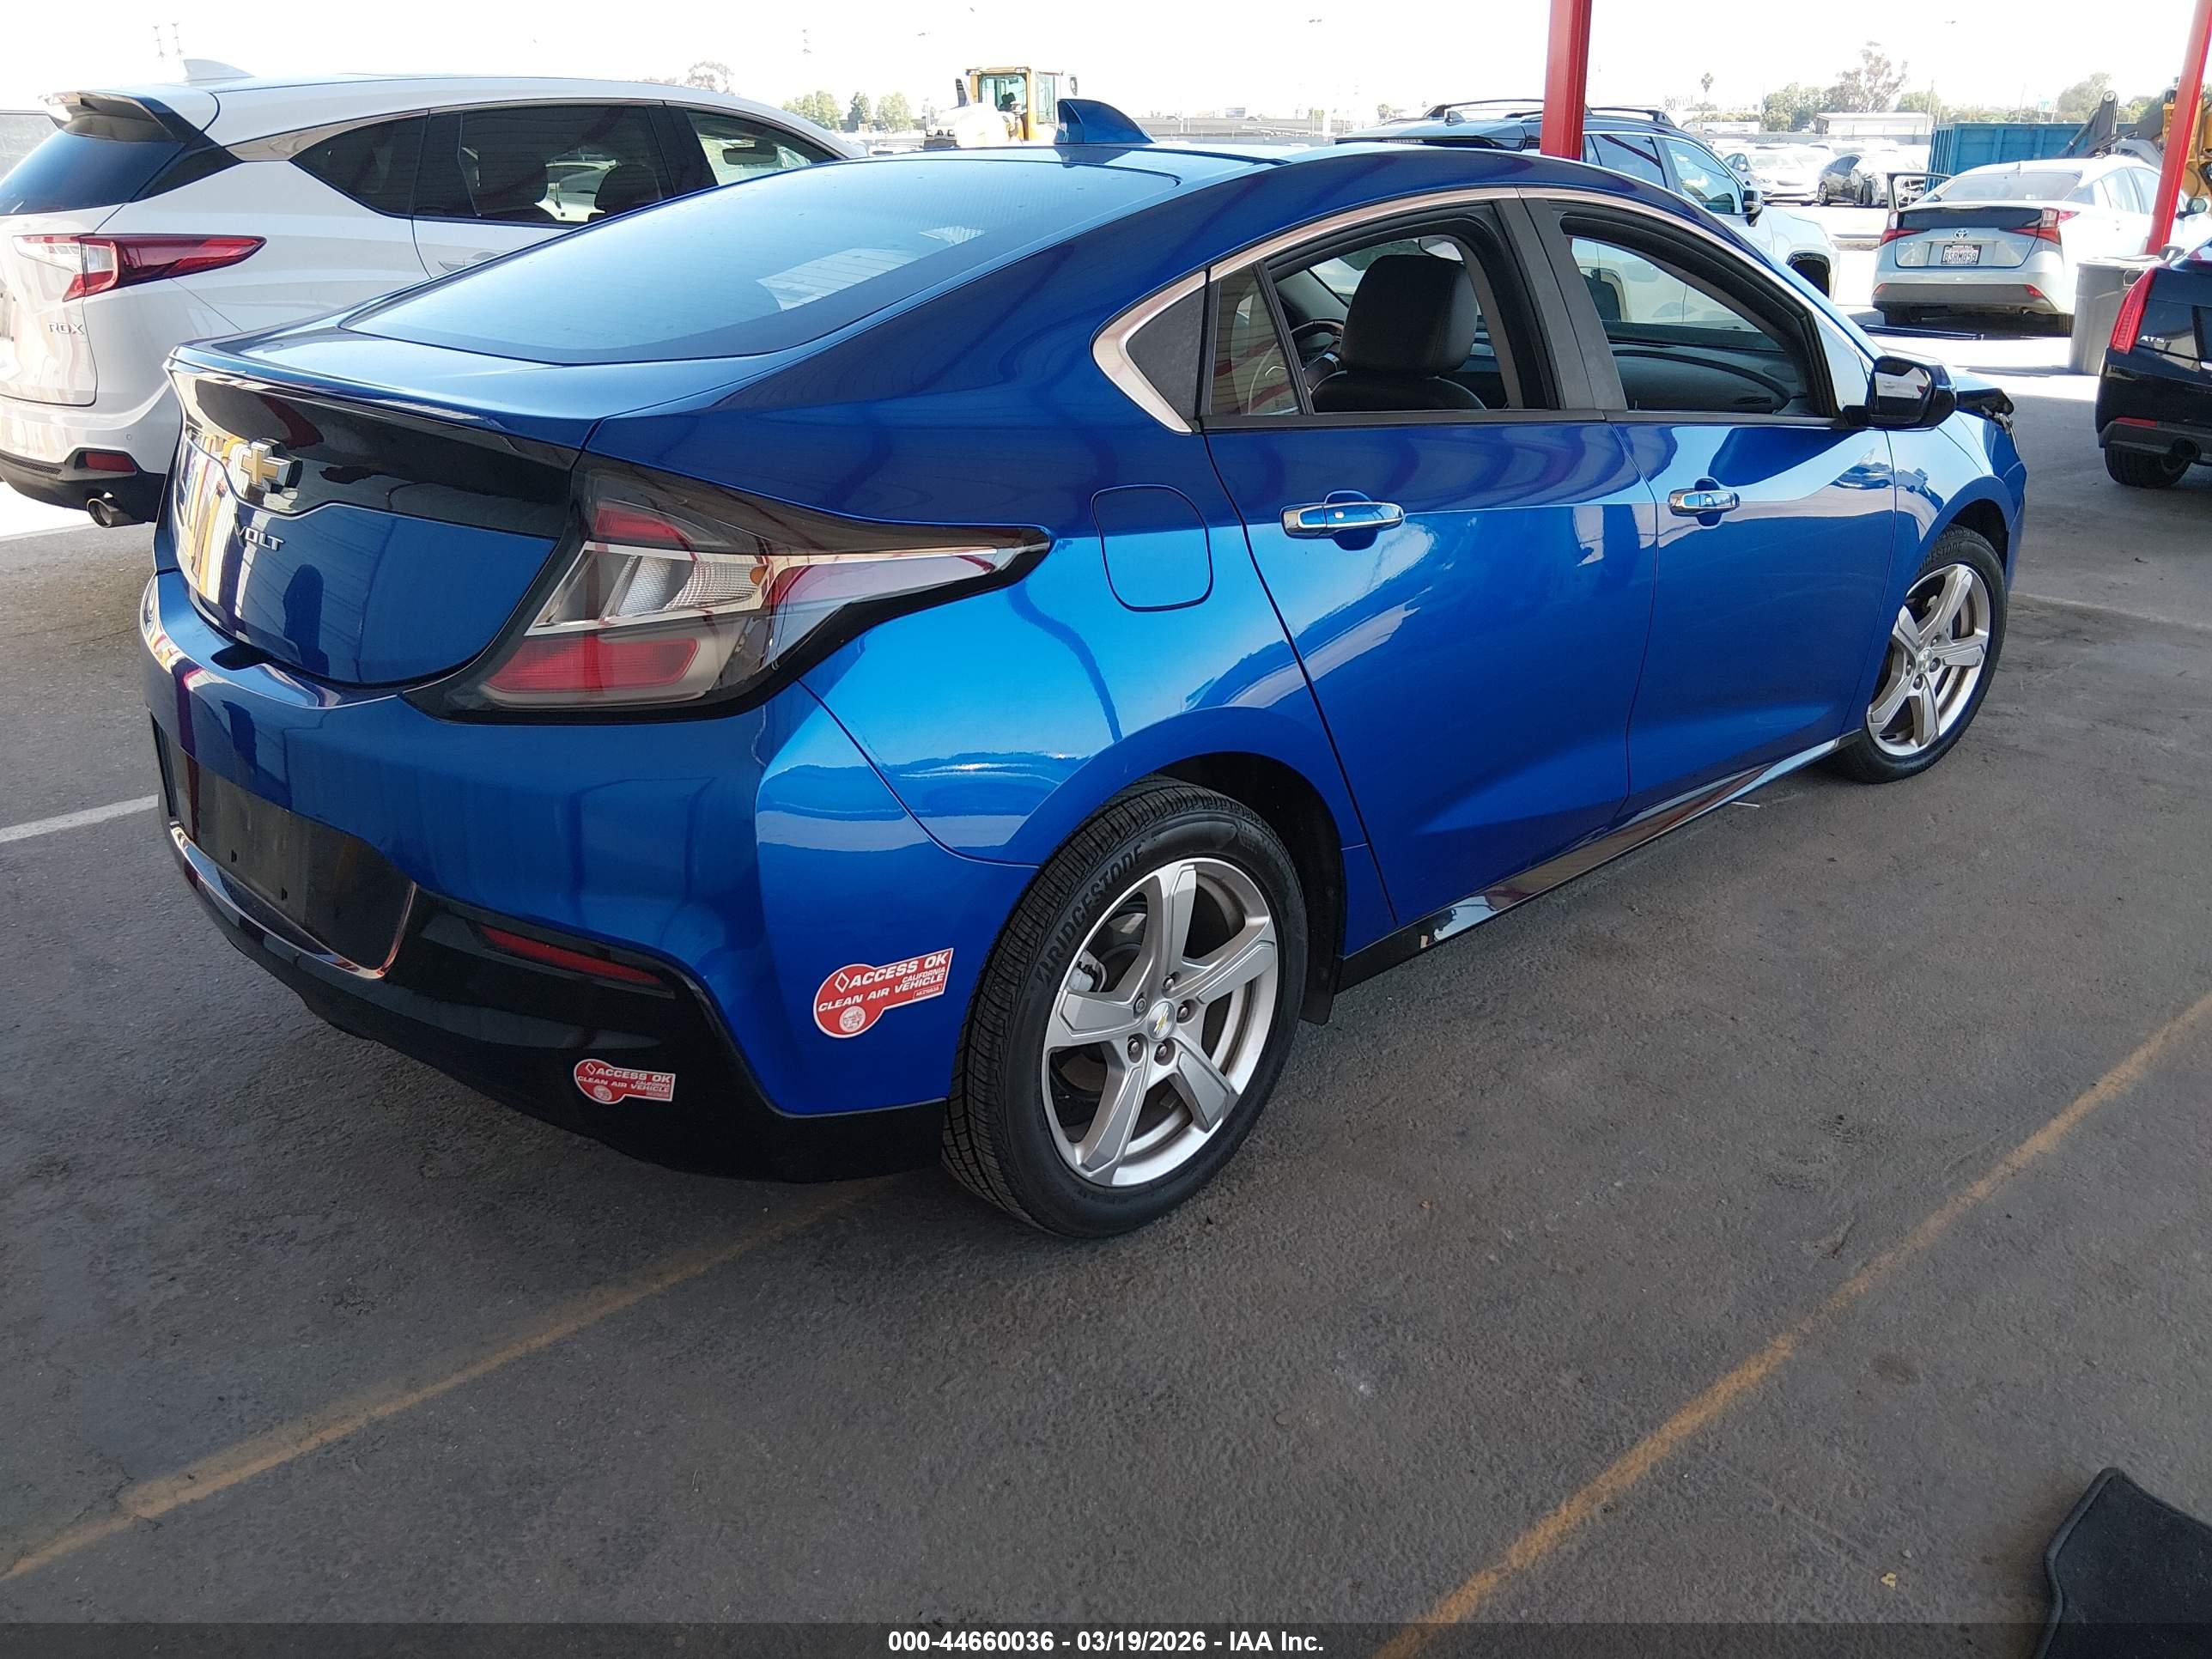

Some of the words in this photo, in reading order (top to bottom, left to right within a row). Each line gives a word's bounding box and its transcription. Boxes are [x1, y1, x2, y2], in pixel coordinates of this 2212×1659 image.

[2140, 335, 2165, 343] ATS
[234, 513, 286, 551] VOLT
[848, 960, 919, 988] ACCESS
[924, 951, 949, 969] OK
[902, 967, 945, 984] CALIFORNIA
[817, 994, 864, 1012] CLEAN
[866, 988, 890, 1001] AIR
[895, 973, 945, 994] VEHICLE
[577, 1075, 609, 1085] CLEAN
[630, 1083, 670, 1093] VEHICLE
[596, 1067, 647, 1080] ACCESS
[652, 1074, 672, 1083] OK
